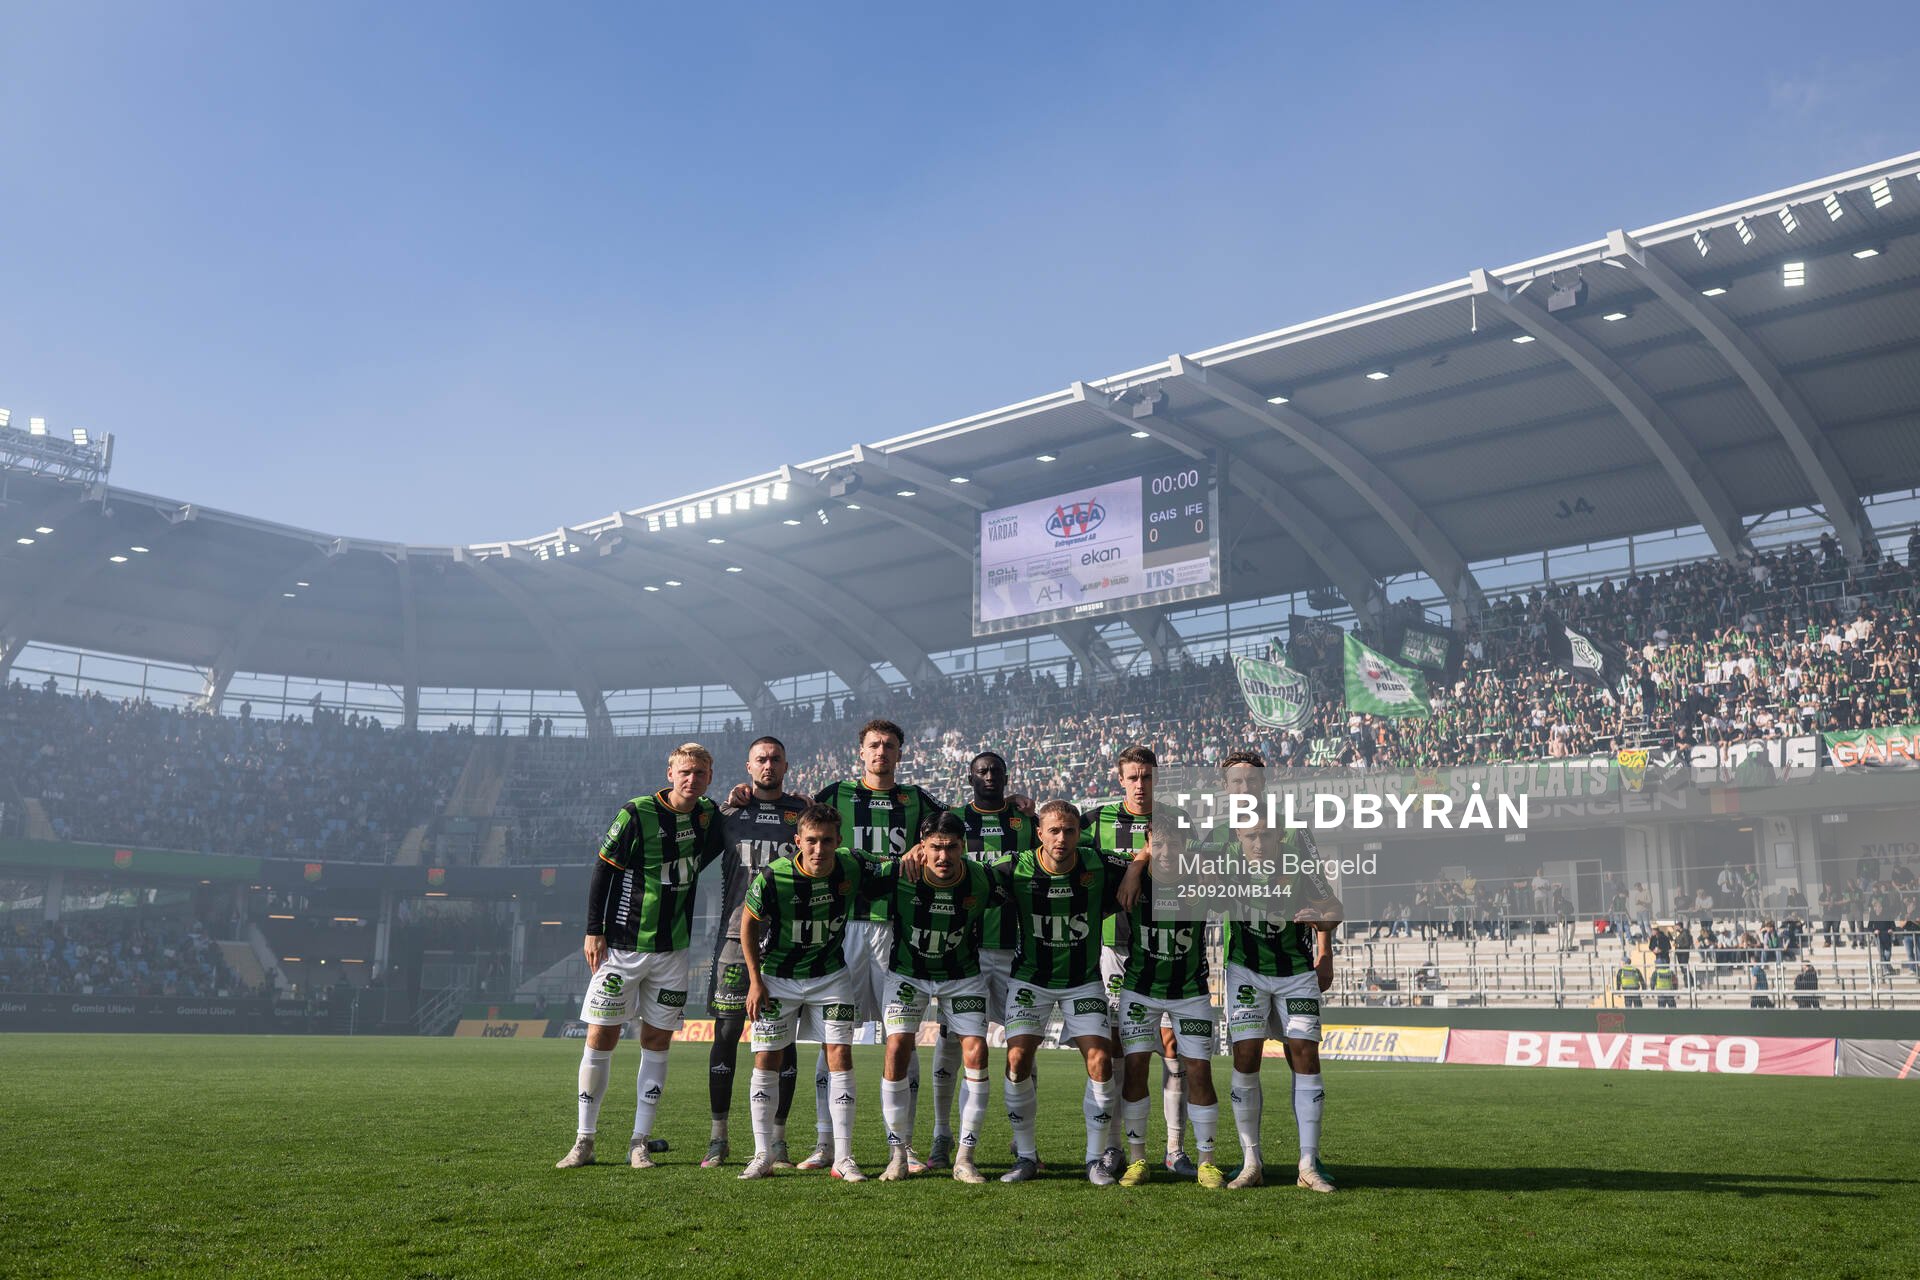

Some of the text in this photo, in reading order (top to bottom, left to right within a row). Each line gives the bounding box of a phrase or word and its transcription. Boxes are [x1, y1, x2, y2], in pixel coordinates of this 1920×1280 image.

[1152, 470, 1198, 495] 00:00
[1050, 508, 1101, 530] AGGA
[1150, 503, 1203, 523] GAIS IFE
[1150, 519, 1203, 542] 0 0
[1081, 547, 1121, 565] ekan
[1146, 568, 1174, 588] ITS
[676, 829, 695, 839] SKAB
[853, 827, 907, 854] ITS
[739, 839, 797, 867] ITS
[811, 894, 833, 902] SKAB
[931, 903, 954, 911] SKAB
[1032, 913, 1090, 941] ITS
[910, 925, 964, 953] ITS
[1139, 924, 1194, 954] ITS
[72, 1003, 136, 1015] Gamla Ullevi
[176, 1006, 236, 1017] Gamla Ullevi
[1321, 1027, 1399, 1052] KLÄDER
[1504, 1031, 1760, 1074] BEVEGO
